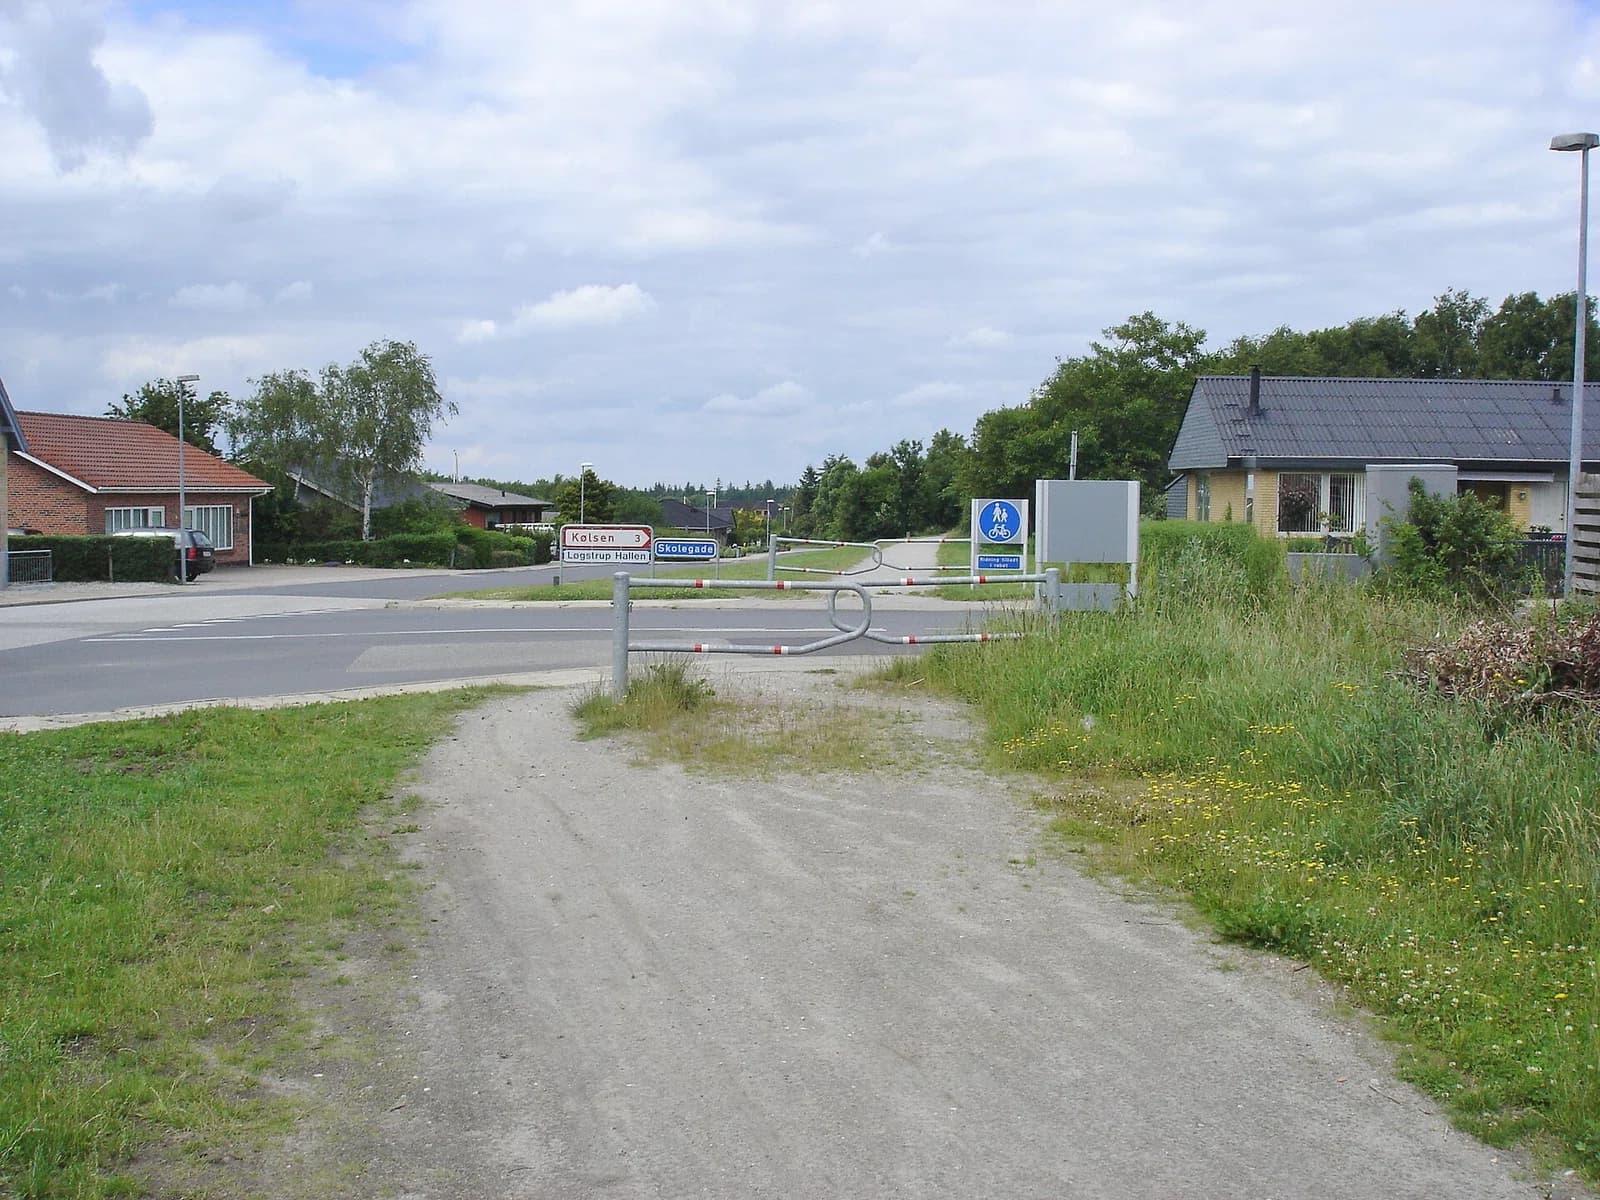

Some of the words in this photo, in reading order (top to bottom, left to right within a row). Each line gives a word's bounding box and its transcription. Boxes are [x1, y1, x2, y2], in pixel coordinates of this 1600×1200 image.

[572, 532, 615, 543] Kølsen
[634, 534, 641, 543] 3
[658, 543, 714, 555] Skolegade
[615, 551, 647, 561] Hallen
